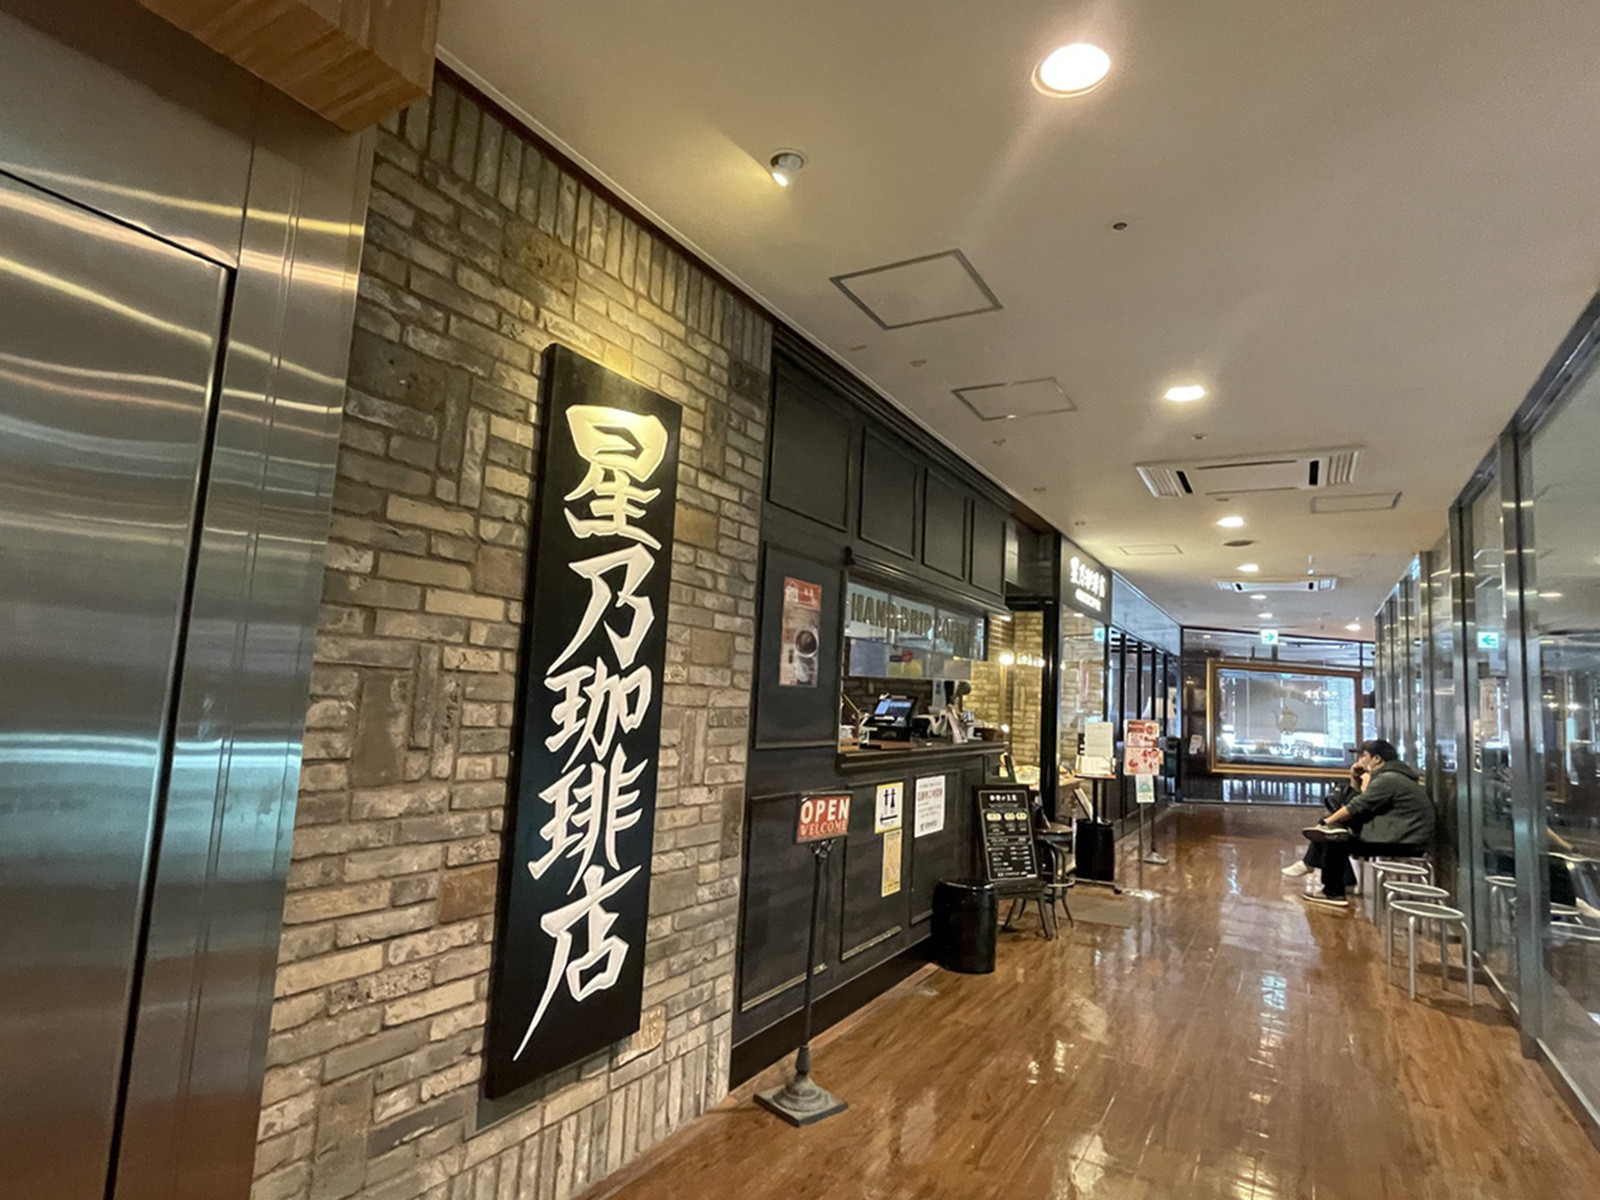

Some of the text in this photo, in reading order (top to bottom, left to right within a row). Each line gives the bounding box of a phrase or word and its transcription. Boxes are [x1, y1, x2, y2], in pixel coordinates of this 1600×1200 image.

[851, 592, 898, 629] HAND
[512, 403, 669, 1062] 星乃珈琲店
[800, 798, 850, 824] OPEN
[799, 820, 848, 836] WELCOME
